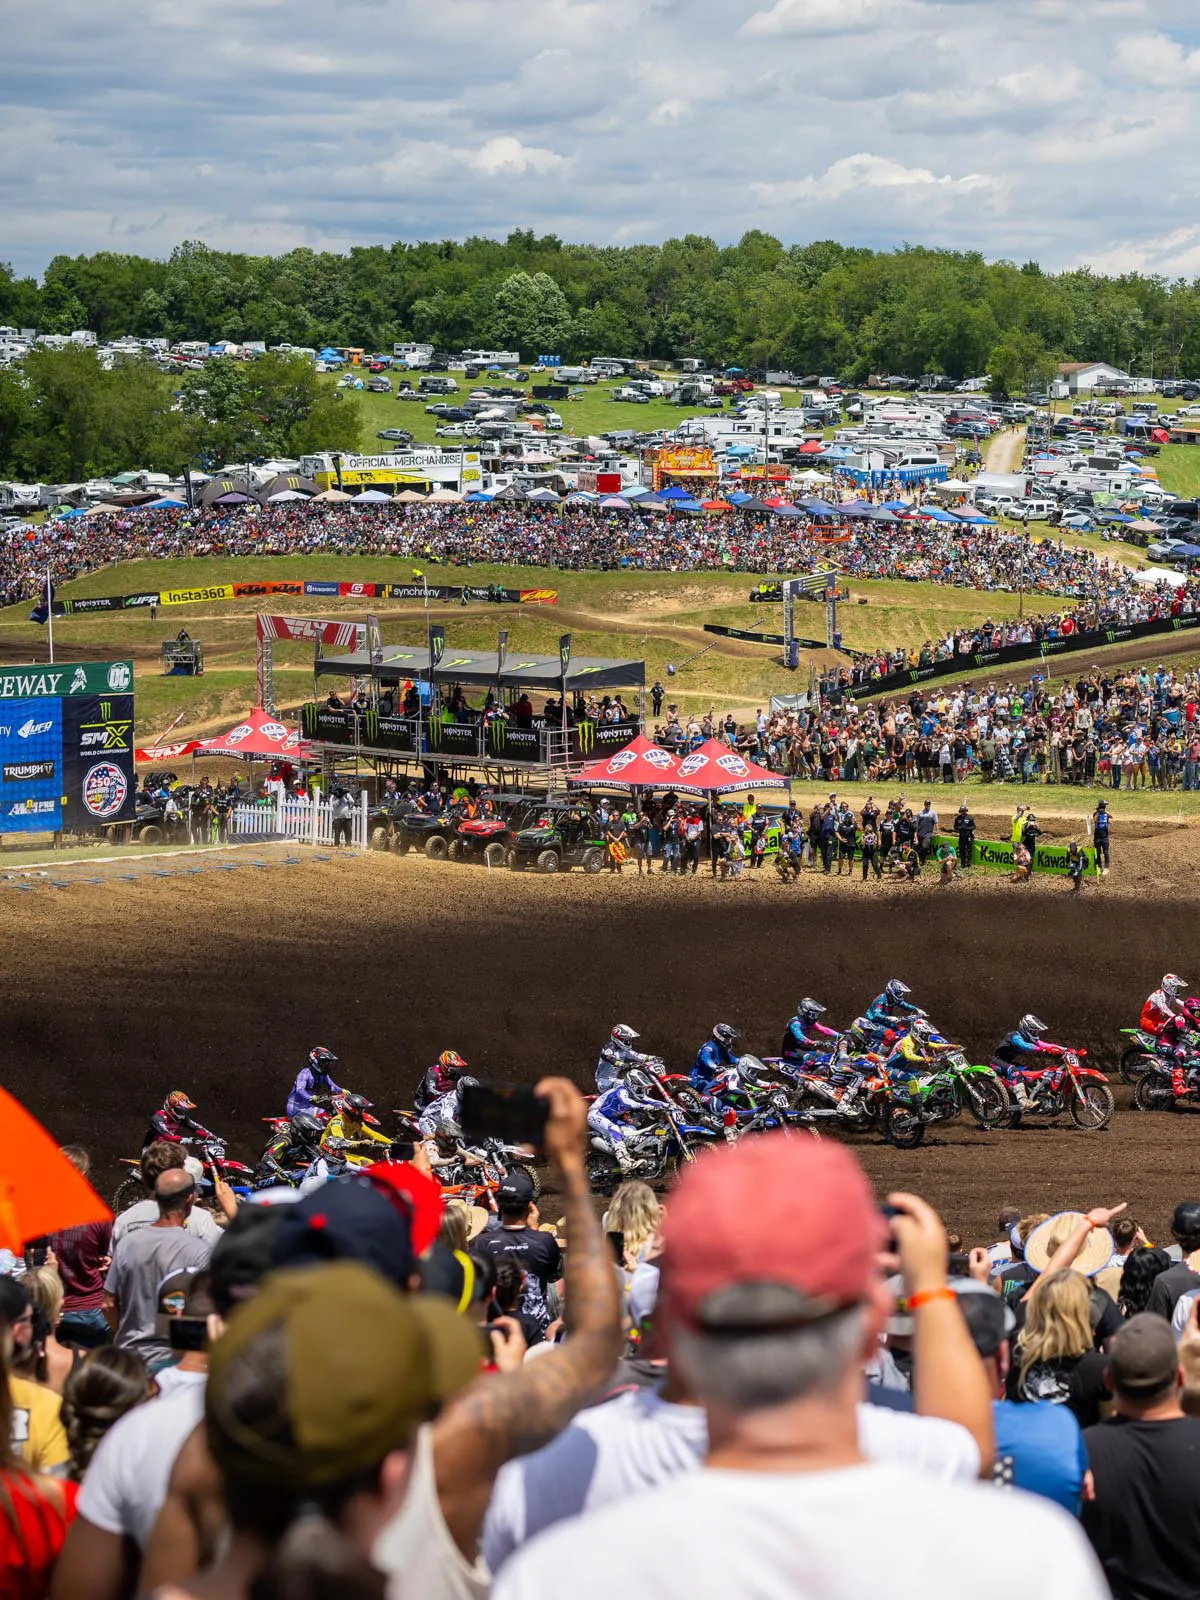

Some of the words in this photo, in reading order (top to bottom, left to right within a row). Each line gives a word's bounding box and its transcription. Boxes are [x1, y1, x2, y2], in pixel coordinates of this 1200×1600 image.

[350, 457, 391, 467] OFFICIAL
[395, 454, 461, 466] MERCHANDISE
[168, 587, 225, 602] Insta360
[237, 585, 267, 596] KTM
[271, 584, 302, 594] KTM
[393, 586, 440, 598] synchrony
[109, 667, 130, 687] DC
[0, 673, 63, 697] EWAY
[506, 732, 537, 742] MONSTER
[596, 729, 633, 739] MONSTER
[4, 764, 44, 777] TRIUMPH
[91, 777, 110, 788] 250
[980, 845, 1014, 864] Kawas
